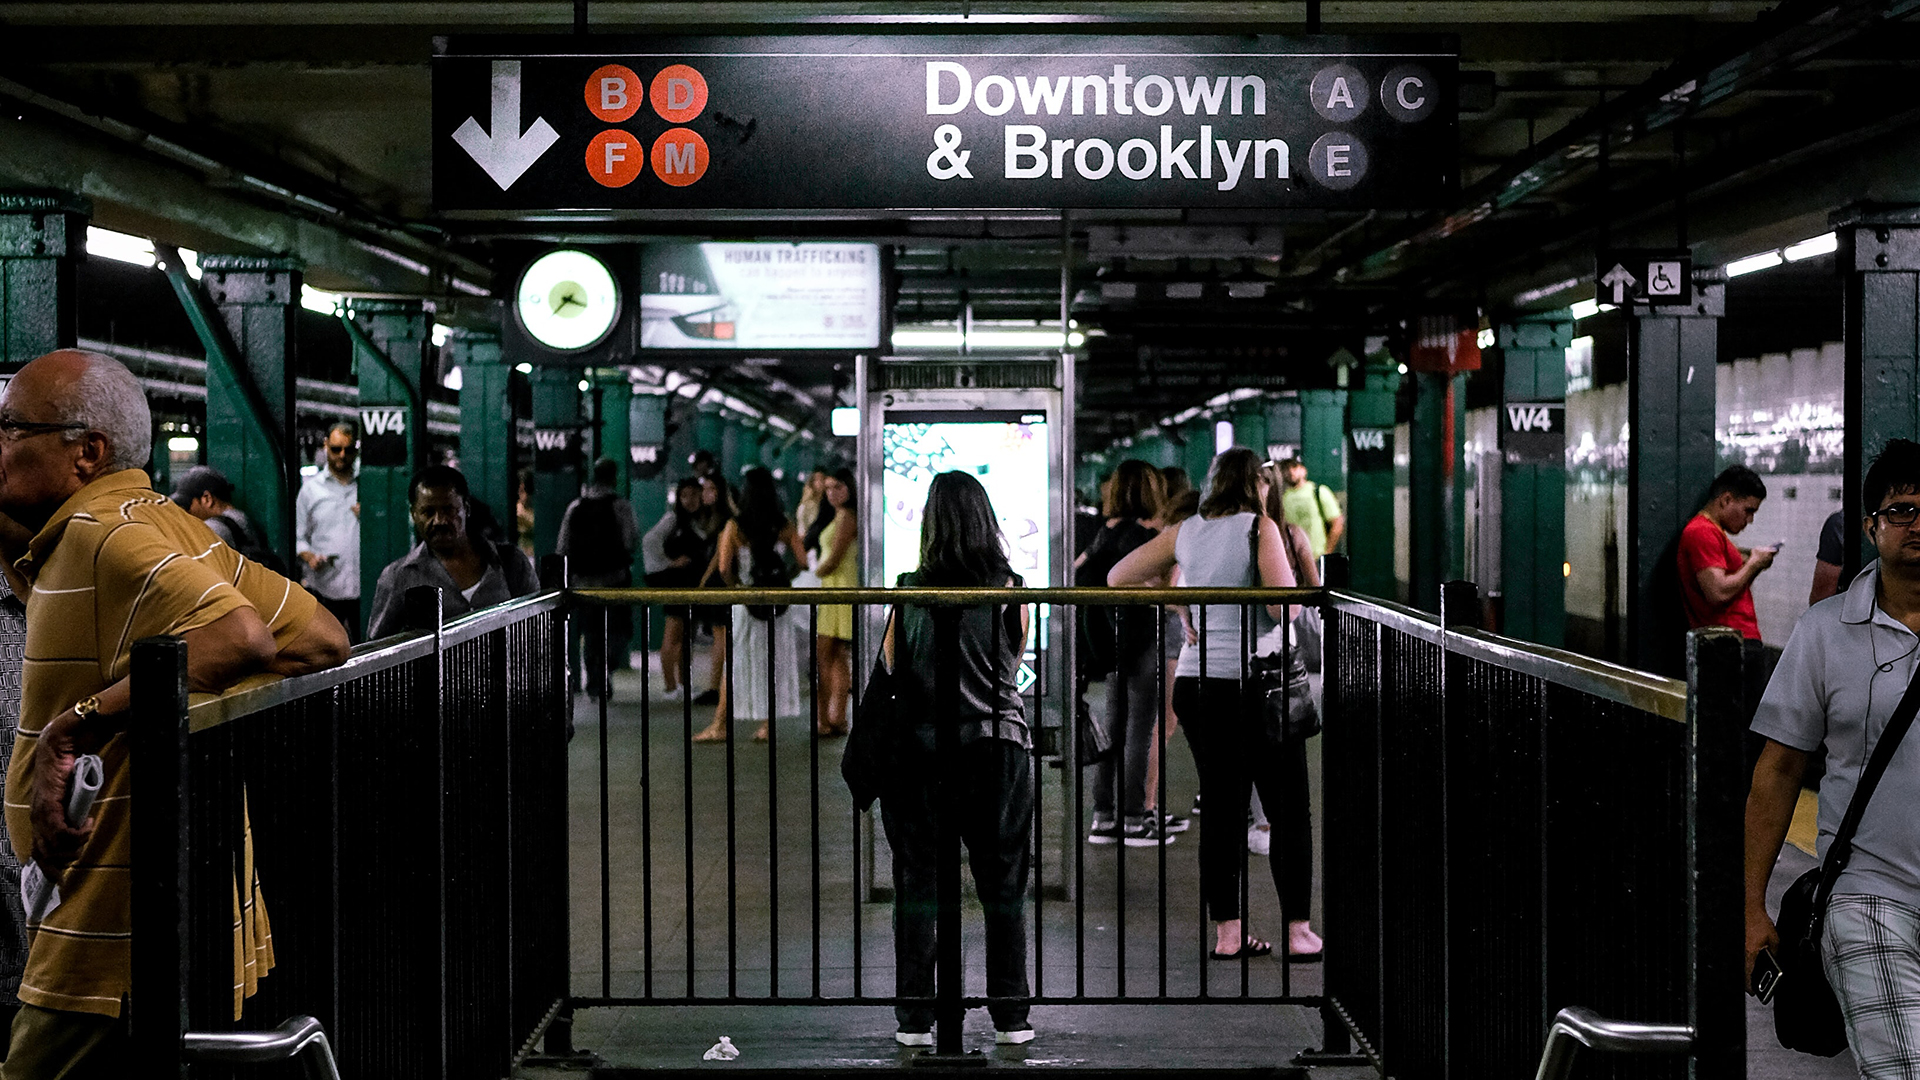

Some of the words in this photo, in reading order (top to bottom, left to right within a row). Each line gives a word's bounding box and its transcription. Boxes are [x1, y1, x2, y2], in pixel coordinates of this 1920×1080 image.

[601, 78, 627, 110] B
[667, 78, 694, 110] D
[926, 62, 1266, 116] Downtown
[1326, 77, 1354, 109] A
[1396, 77, 1425, 110] C
[605, 143, 628, 174] F
[665, 143, 696, 174] M
[926, 124, 974, 180] &
[1004, 125, 1290, 192] Brooklyn
[1327, 145, 1351, 177] E
[724, 250, 771, 264] HUMAN
[777, 250, 866, 264] TRAFFICKING
[362, 410, 406, 436] W4
[1508, 406, 1553, 432] W4
[535, 430, 566, 451] W4
[1352, 429, 1386, 451] W4
